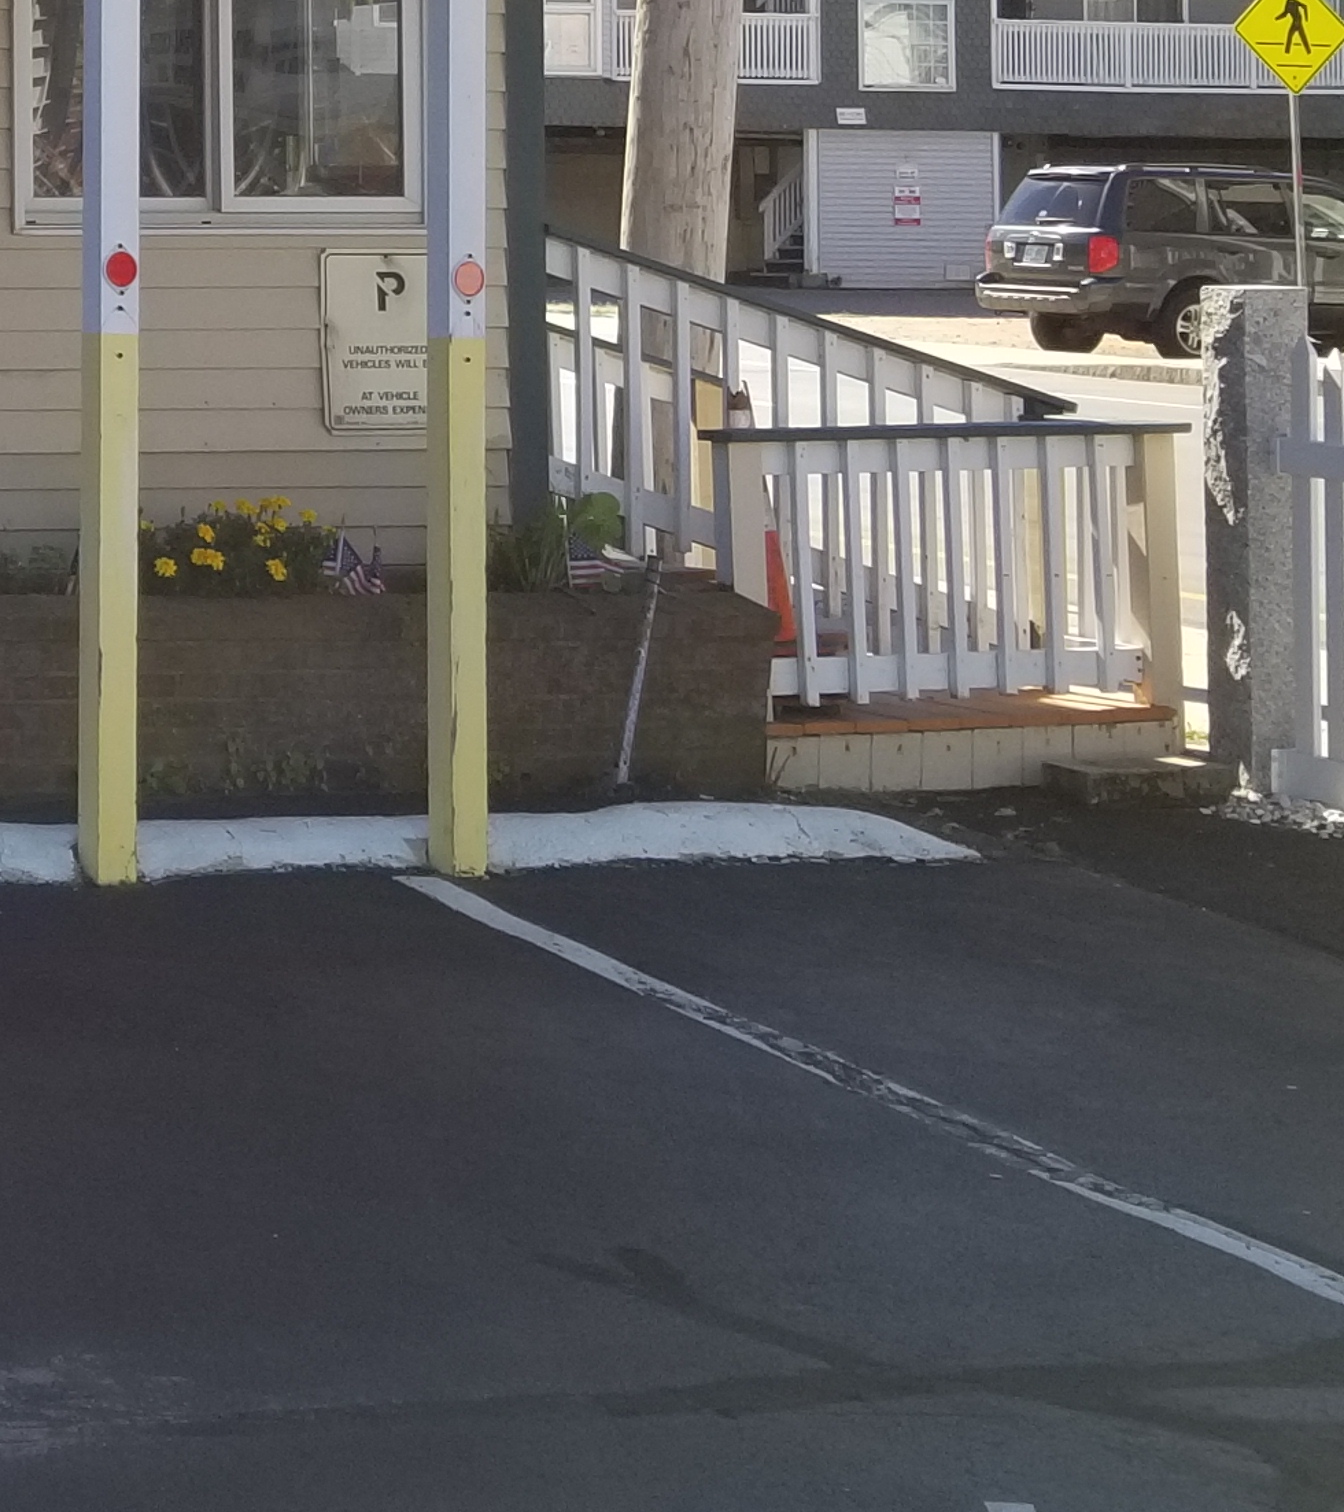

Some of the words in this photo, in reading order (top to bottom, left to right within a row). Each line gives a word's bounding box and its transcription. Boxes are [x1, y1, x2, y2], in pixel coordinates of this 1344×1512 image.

[348, 345, 428, 355] UNAUTHORIZED
[342, 359, 391, 369] VEHICLES
[395, 359, 419, 369] WILL
[361, 391, 374, 401] AT
[377, 391, 419, 401] VEHICLE
[343, 405, 389, 415] OWNERS
[392, 405, 426, 415] EXPEN
